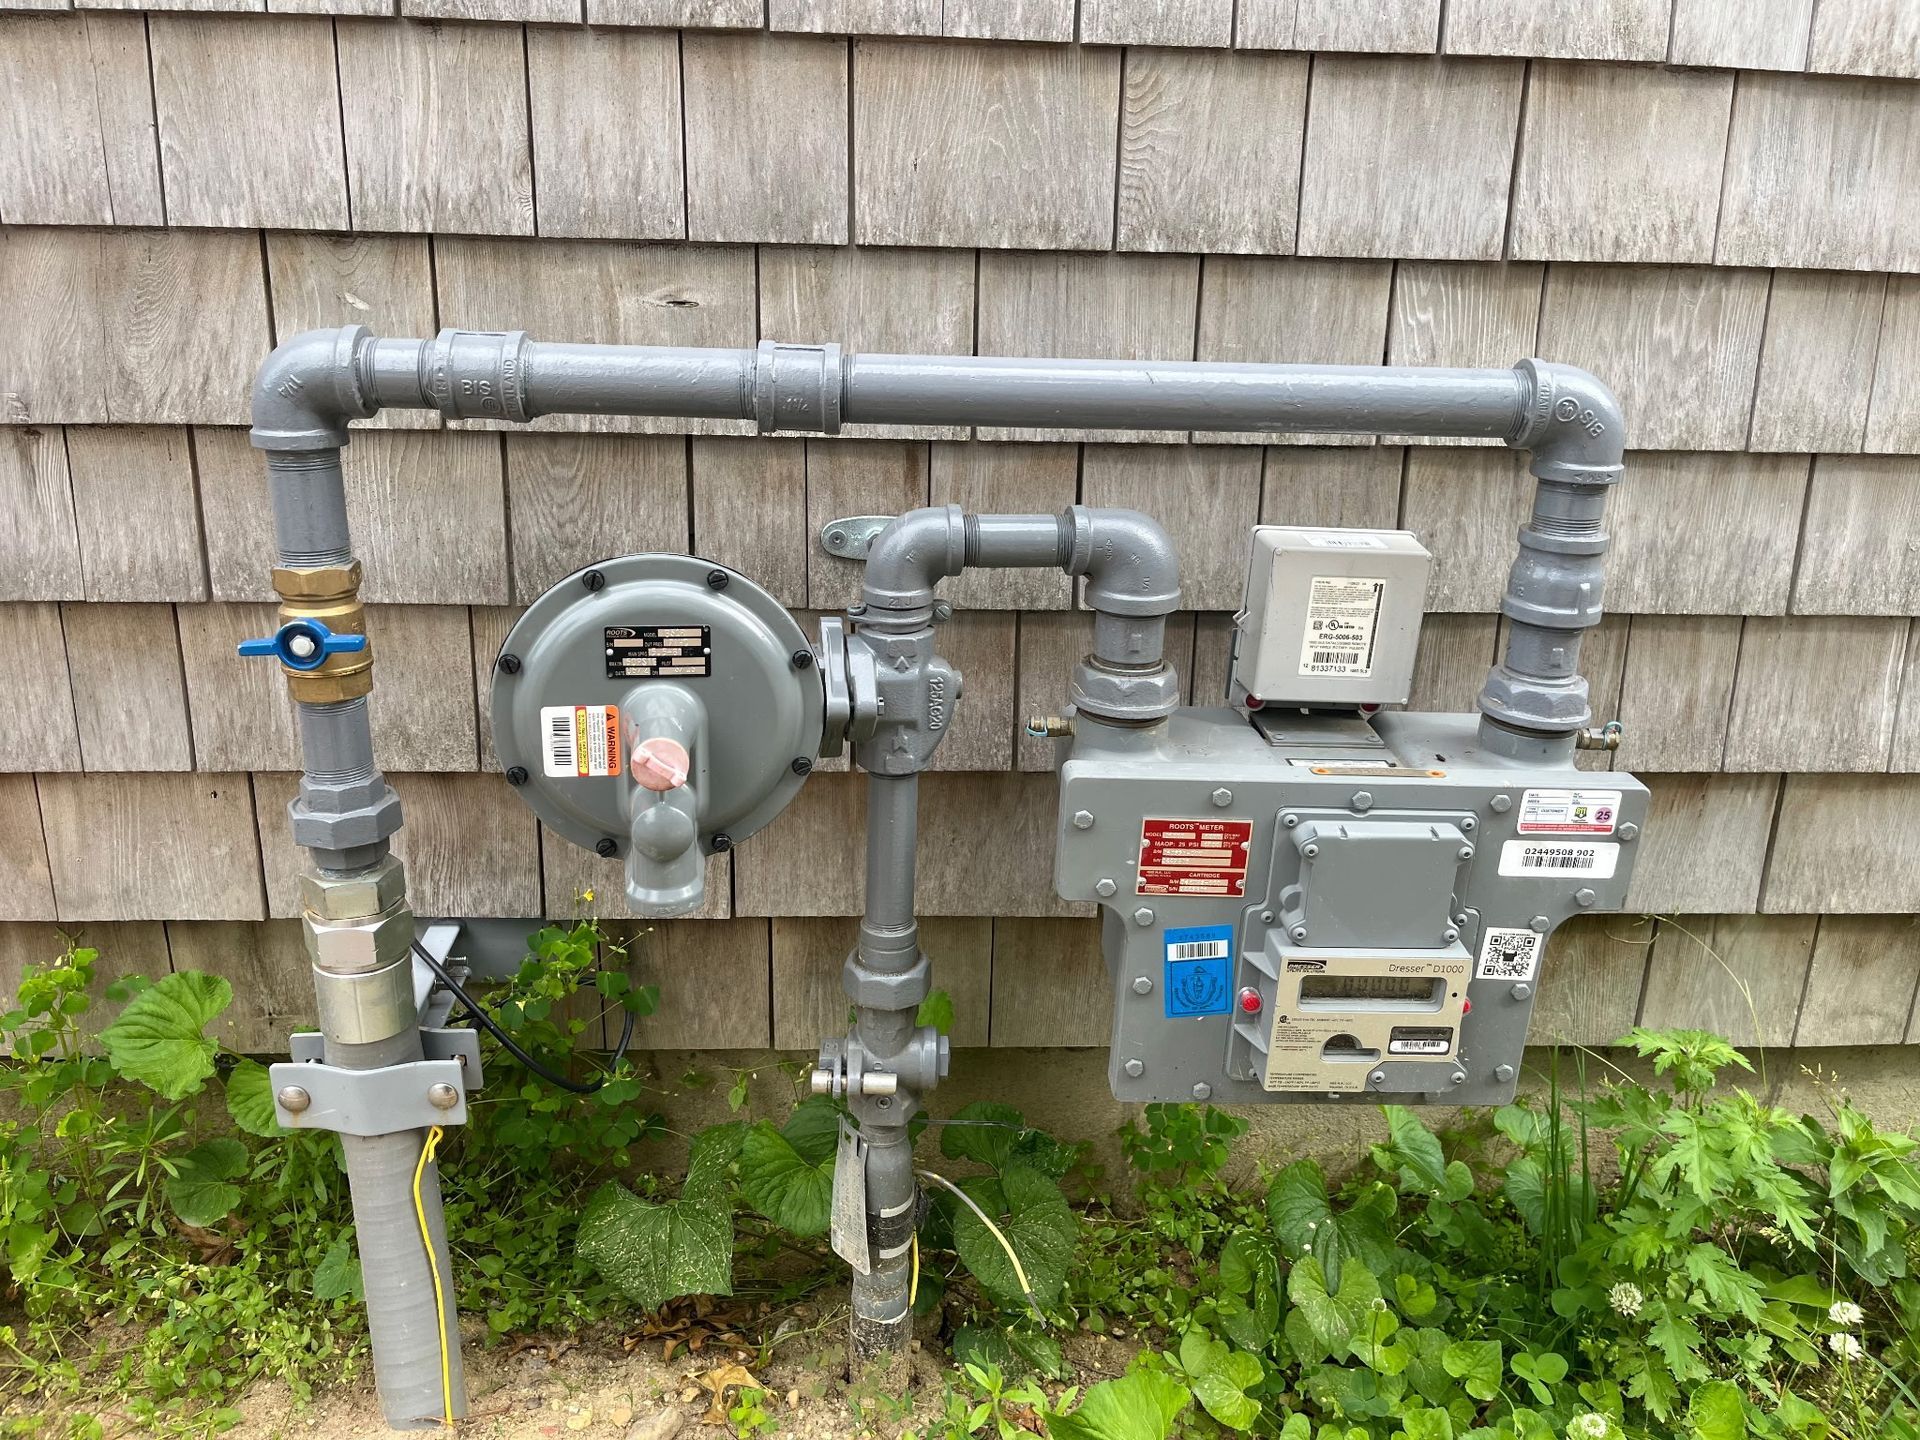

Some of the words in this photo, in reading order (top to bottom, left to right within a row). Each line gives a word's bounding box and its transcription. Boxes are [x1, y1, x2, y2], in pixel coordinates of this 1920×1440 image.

[461, 379, 491, 395] BIS
[607, 726, 617, 769] WARNING
[1596, 811, 1610, 820] 25
[1524, 848, 1573, 856] 02449508
[1576, 849, 1595, 857] 902
[1433, 964, 1464, 973] D1000
